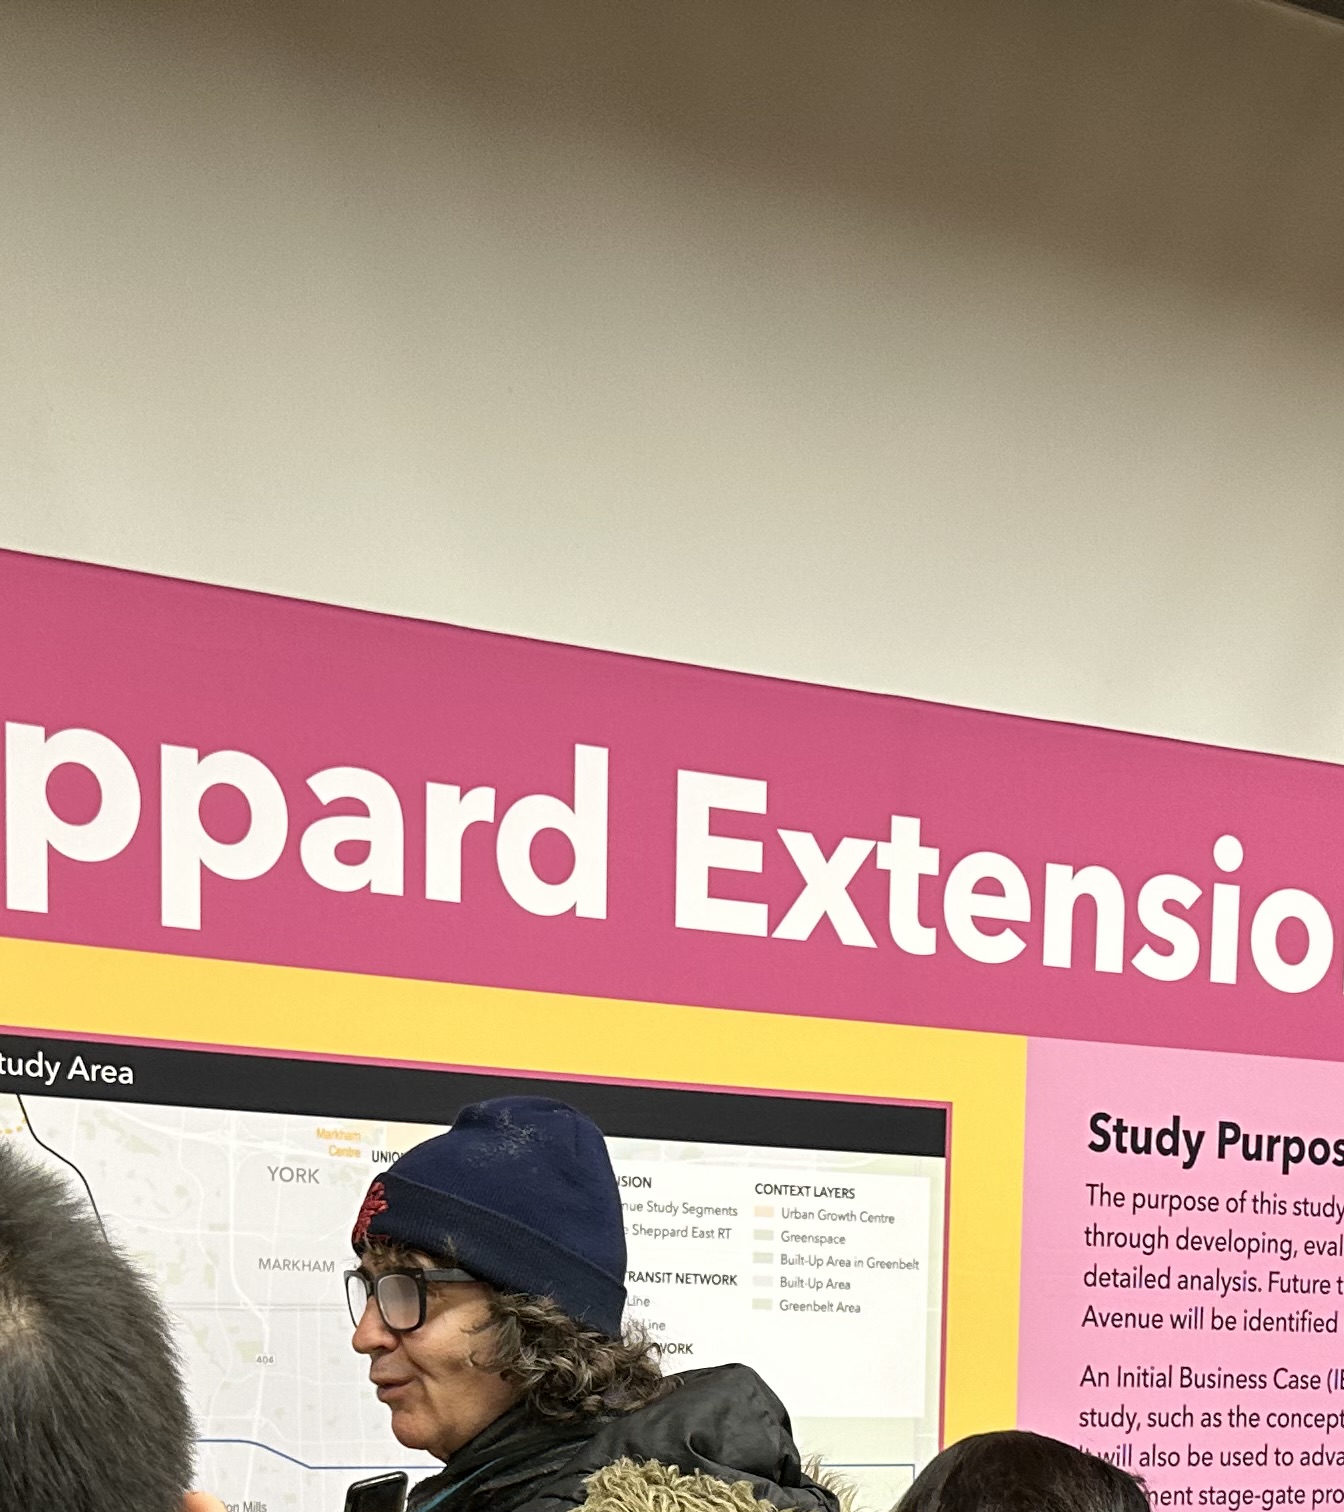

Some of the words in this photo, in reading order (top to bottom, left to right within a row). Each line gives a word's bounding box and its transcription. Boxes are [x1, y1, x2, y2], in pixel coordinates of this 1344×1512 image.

[67, 1055, 134, 1085] Area
[1087, 1112, 1206, 1170] Study
[267, 1165, 320, 1185] YORK
[754, 1182, 812, 1197] CONTEXT
[813, 1186, 856, 1200] LAYERS
[1085, 1182, 1126, 1208] The
[1132, 1192, 1220, 1218] purpose
[1225, 1189, 1248, 1214] of
[1251, 1190, 1287, 1216] this
[646, 1200, 679, 1217] Study
[681, 1201, 739, 1219] Segments
[781, 1207, 815, 1220] Urban
[817, 1208, 857, 1222] Growth
[859, 1210, 896, 1225] Centre
[632, 1223, 689, 1240] Sheppard
[691, 1226, 715, 1239] East
[717, 1227, 732, 1240] RT
[780, 1230, 846, 1247] Greenspace
[1084, 1222, 1169, 1256] through
[1175, 1226, 1298, 1262] developing,
[258, 1257, 335, 1273] MARKHAM
[780, 1253, 824, 1269] Built-Up
[825, 1255, 852, 1268] Area
[853, 1255, 864, 1268] in
[866, 1256, 920, 1271] Greenbelt
[675, 1272, 738, 1286] NETWORK
[826, 1279, 851, 1291] Area
[1083, 1262, 1171, 1290] detailed
[1177, 1267, 1262, 1299] analysis.
[1268, 1270, 1331, 1295] Future
[779, 1299, 834, 1313] Greenbelt
[835, 1301, 861, 1314] Area
[1081, 1304, 1164, 1330] Avenue
[1169, 1306, 1204, 1330] will
[1211, 1306, 1237, 1331] be
[1243, 1307, 1338, 1334] identified
[1079, 1364, 1110, 1388] An
[1117, 1364, 1173, 1389] Initial
[1179, 1366, 1267, 1390] Business
[1273, 1367, 1321, 1391] Case
[1079, 1403, 1141, 1435] study,
[1147, 1404, 1194, 1428] such
[1200, 1412, 1222, 1428] as
[1227, 1404, 1261, 1428] the
[1138, 1443, 1181, 1468] also
[1187, 1443, 1214, 1467] be
[1220, 1443, 1268, 1467] used
[1273, 1447, 1294, 1467] to
[1198, 1485, 1306, 1512] stage-gate
